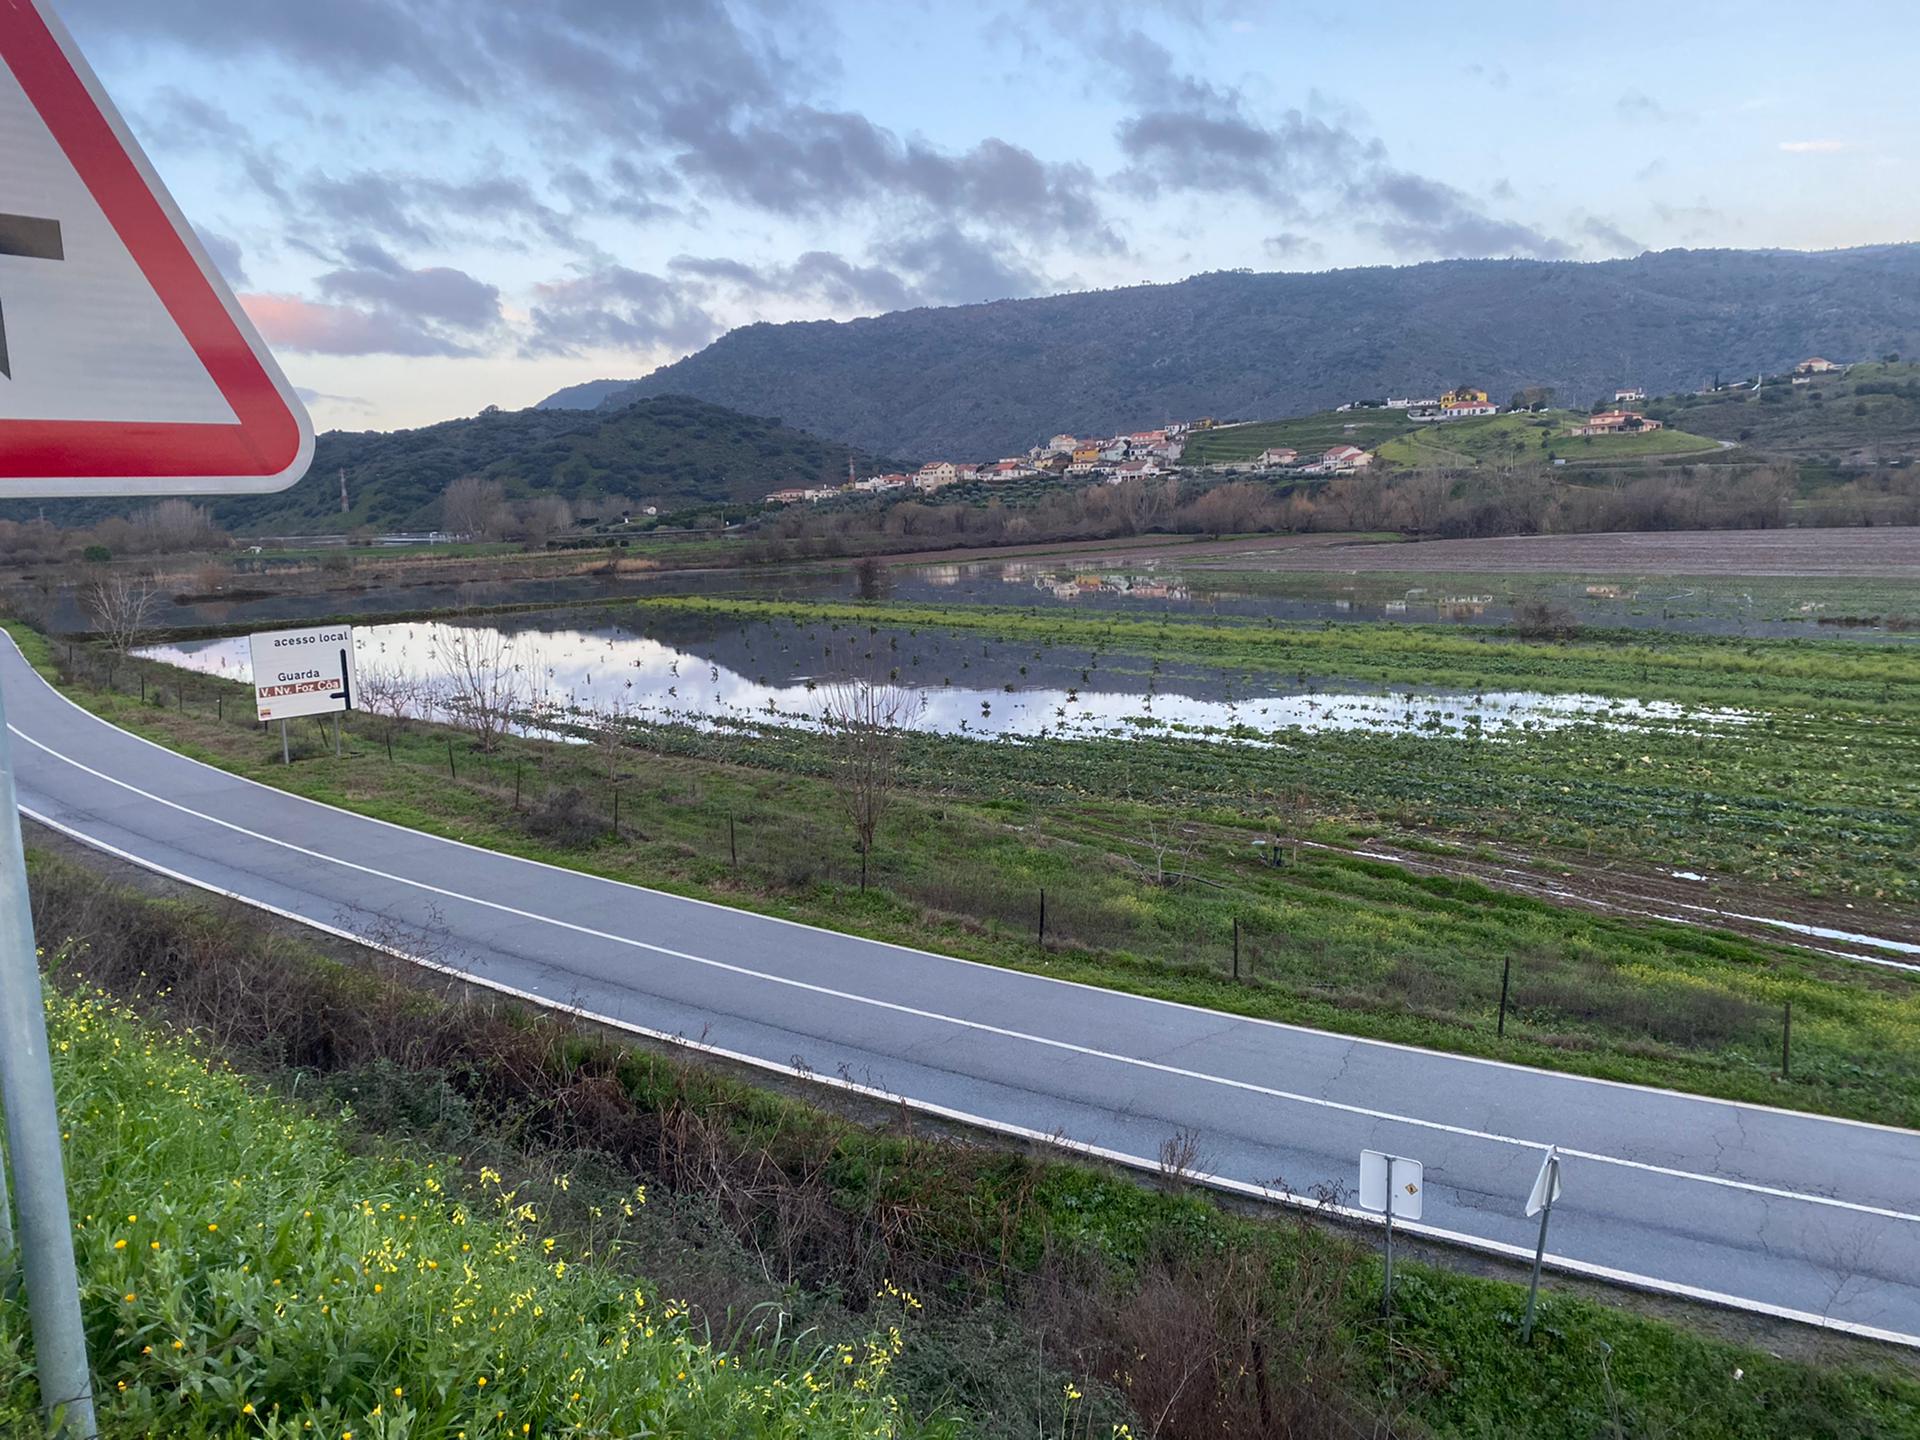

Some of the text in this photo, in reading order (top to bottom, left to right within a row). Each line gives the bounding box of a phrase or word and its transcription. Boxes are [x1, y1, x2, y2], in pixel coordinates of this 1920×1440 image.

[274, 631, 348, 647] acesso local
[278, 669, 320, 681] Guarda
[261, 680, 339, 697] V. Nv. Foz Côa
